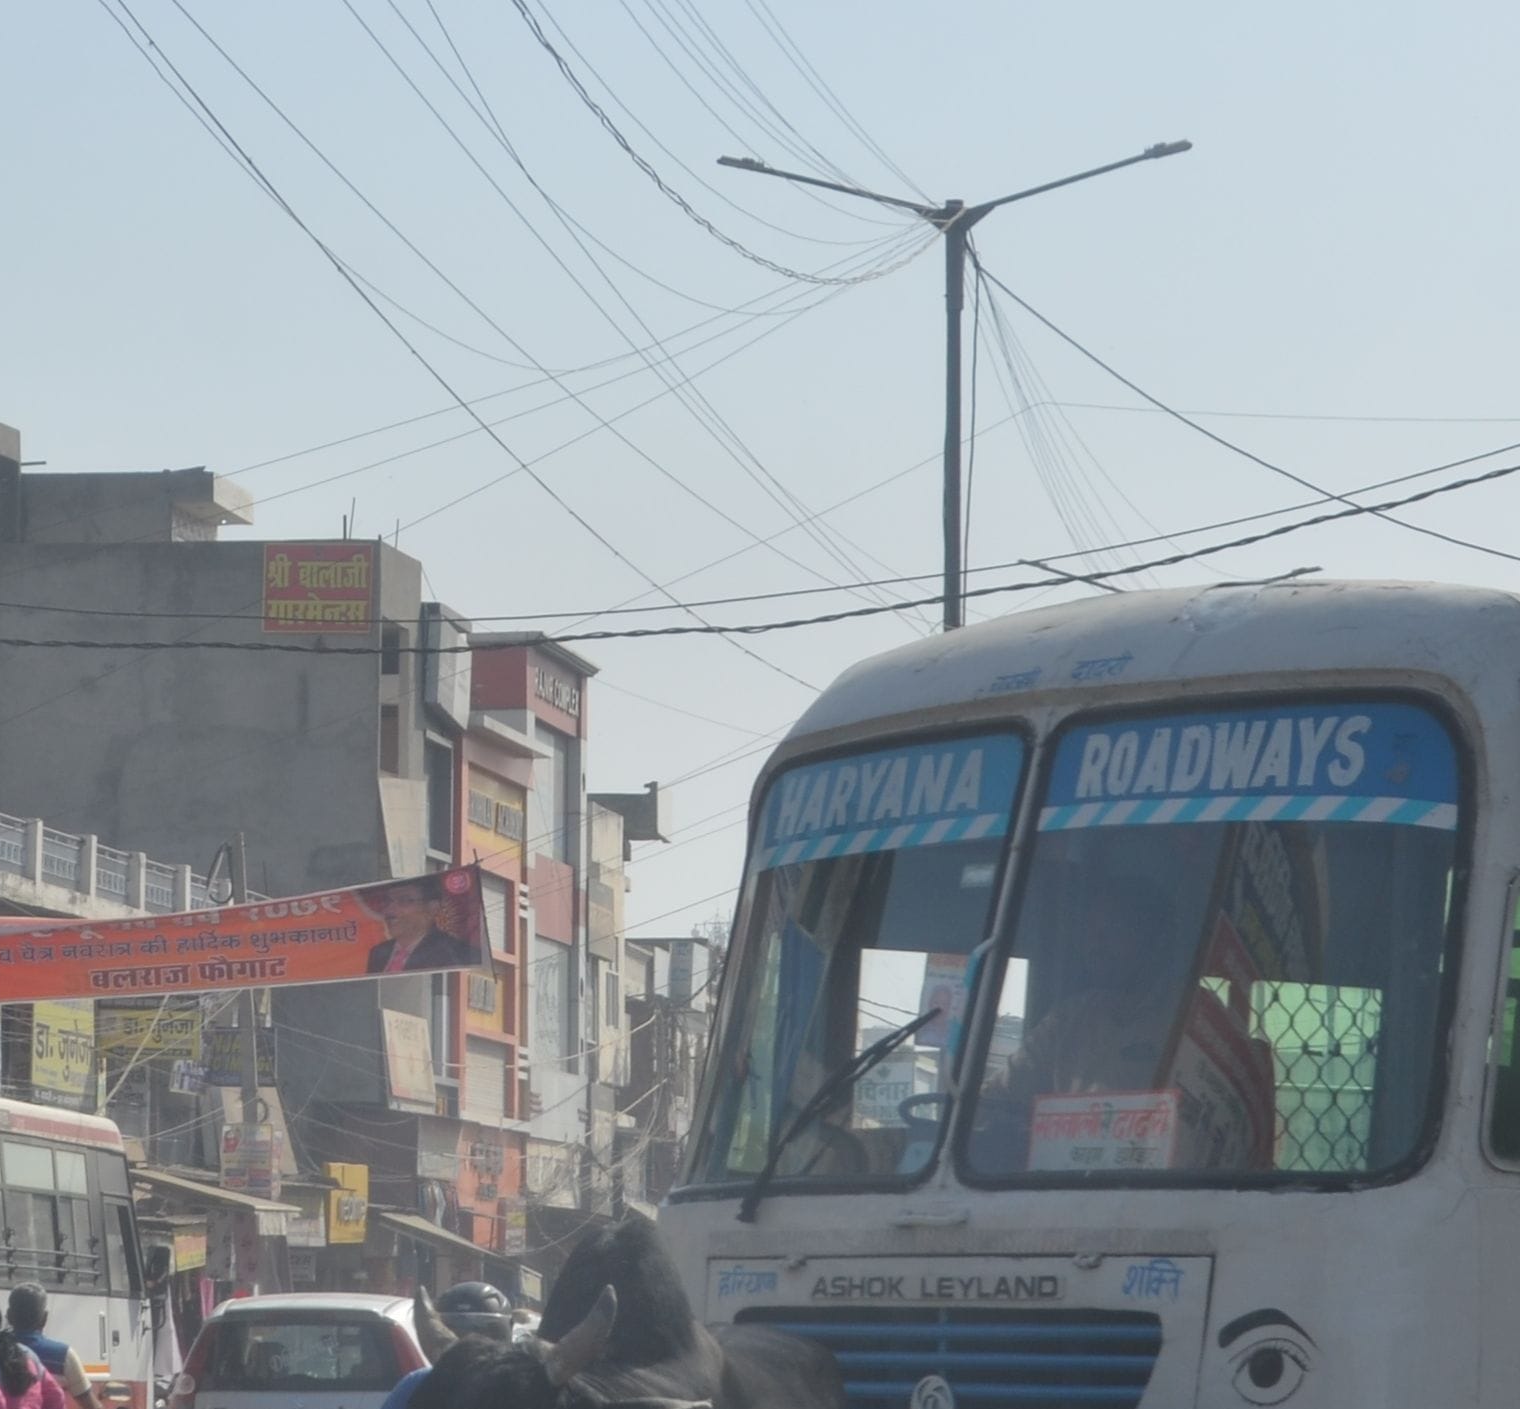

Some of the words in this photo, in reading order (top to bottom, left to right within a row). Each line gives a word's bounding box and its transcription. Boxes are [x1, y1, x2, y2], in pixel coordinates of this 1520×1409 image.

[267, 553, 292, 589] श्री
[298, 554, 369, 589] बालाजी
[777, 747, 986, 841] HARYANA
[1075, 714, 1375, 800] ROADWAYS
[140, 934, 169, 956] की
[177, 929, 241, 954] हार्दिक
[89, 963, 192, 991] बलराज
[197, 954, 287, 983] फौगाट
[1113, 1100, 1171, 1139] दादरी
[810, 1275, 905, 1299] ASHOK
[920, 1274, 1060, 1299] LEYLAND
